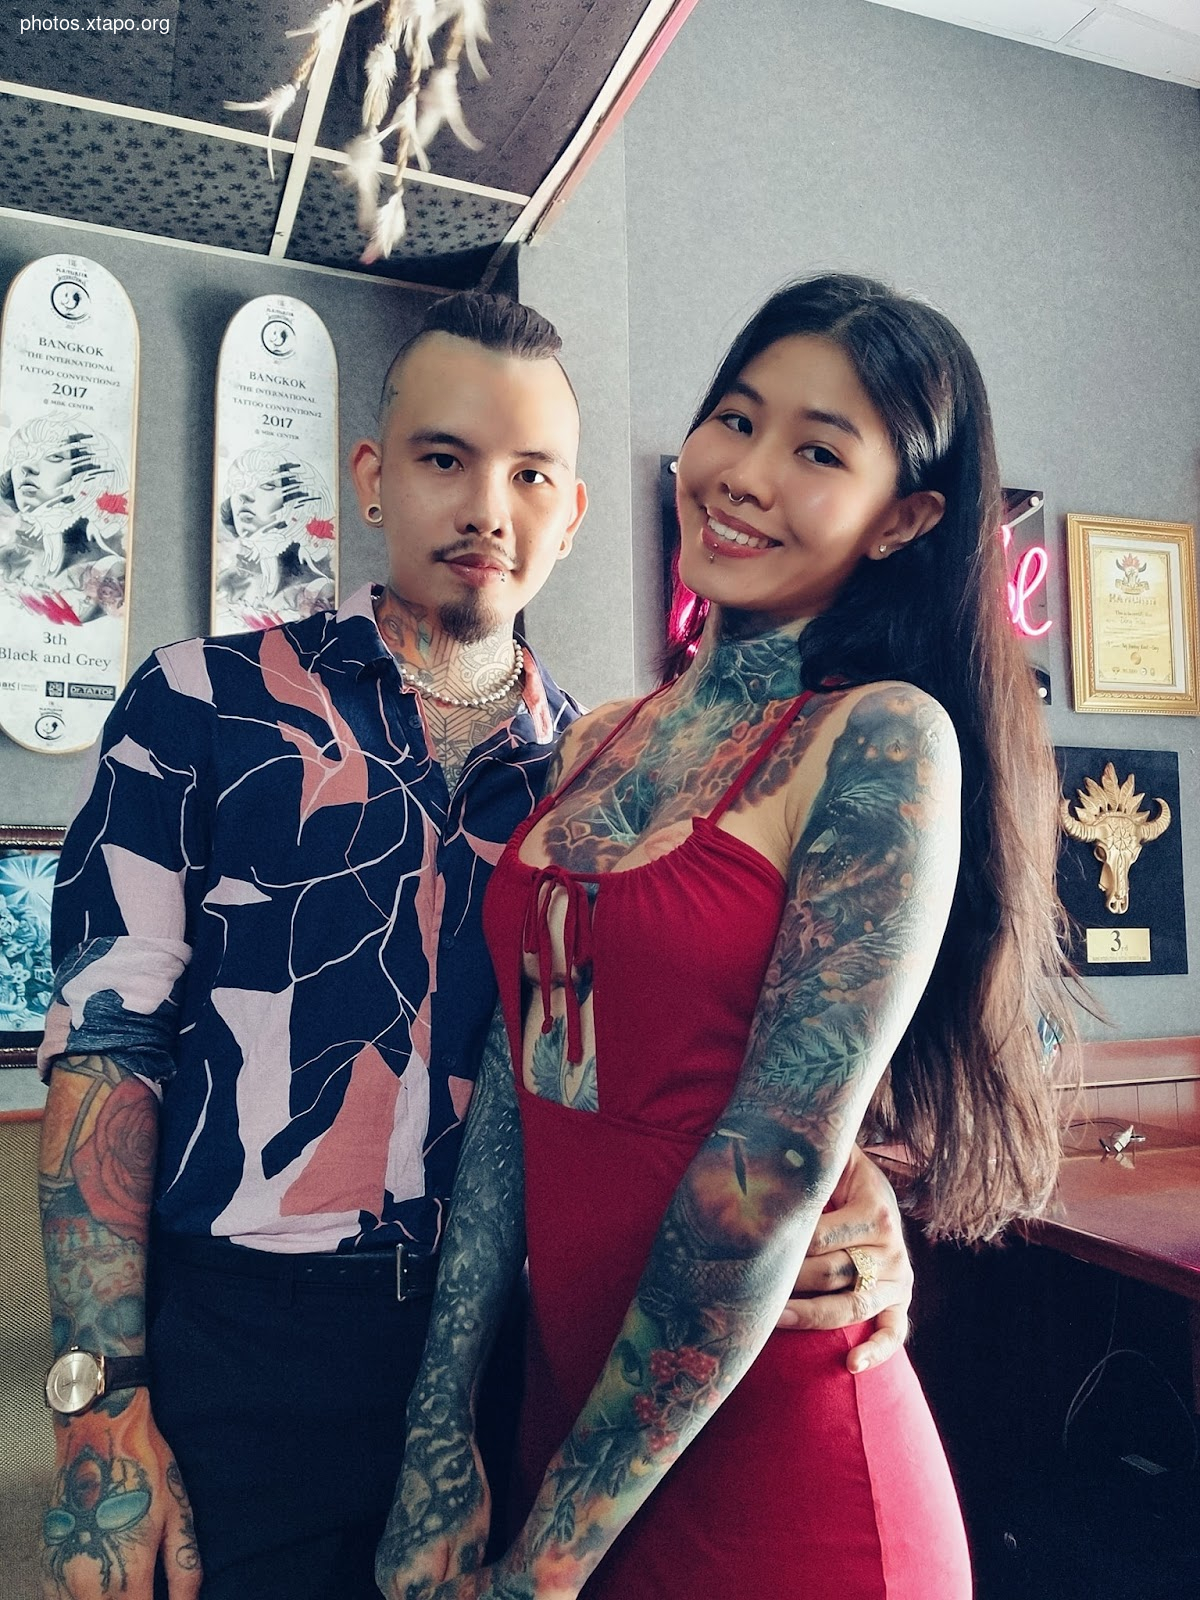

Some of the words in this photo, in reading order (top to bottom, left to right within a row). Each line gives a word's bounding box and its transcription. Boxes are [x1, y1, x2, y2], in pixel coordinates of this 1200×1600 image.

[39, 337, 104, 357] BANGKOK
[25, 351, 43, 361] THE
[46, 355, 115, 372] INTERNATIONAL
[19, 364, 54, 377] TATTOO
[249, 371, 307, 389] BANGKOK
[52, 383, 87, 398] 2017
[238, 384, 253, 393] THE
[255, 387, 317, 404] INTERNATIONAL
[68, 402, 95, 411] CENTER
[232, 397, 264, 408] TATTOO
[262, 414, 293, 429] 2017
[276, 432, 300, 440] CENTER
[42, 631, 67, 645] 3th
[0, 647, 38, 662] Black
[43, 653, 71, 664] and
[76, 653, 111, 671] Grey
